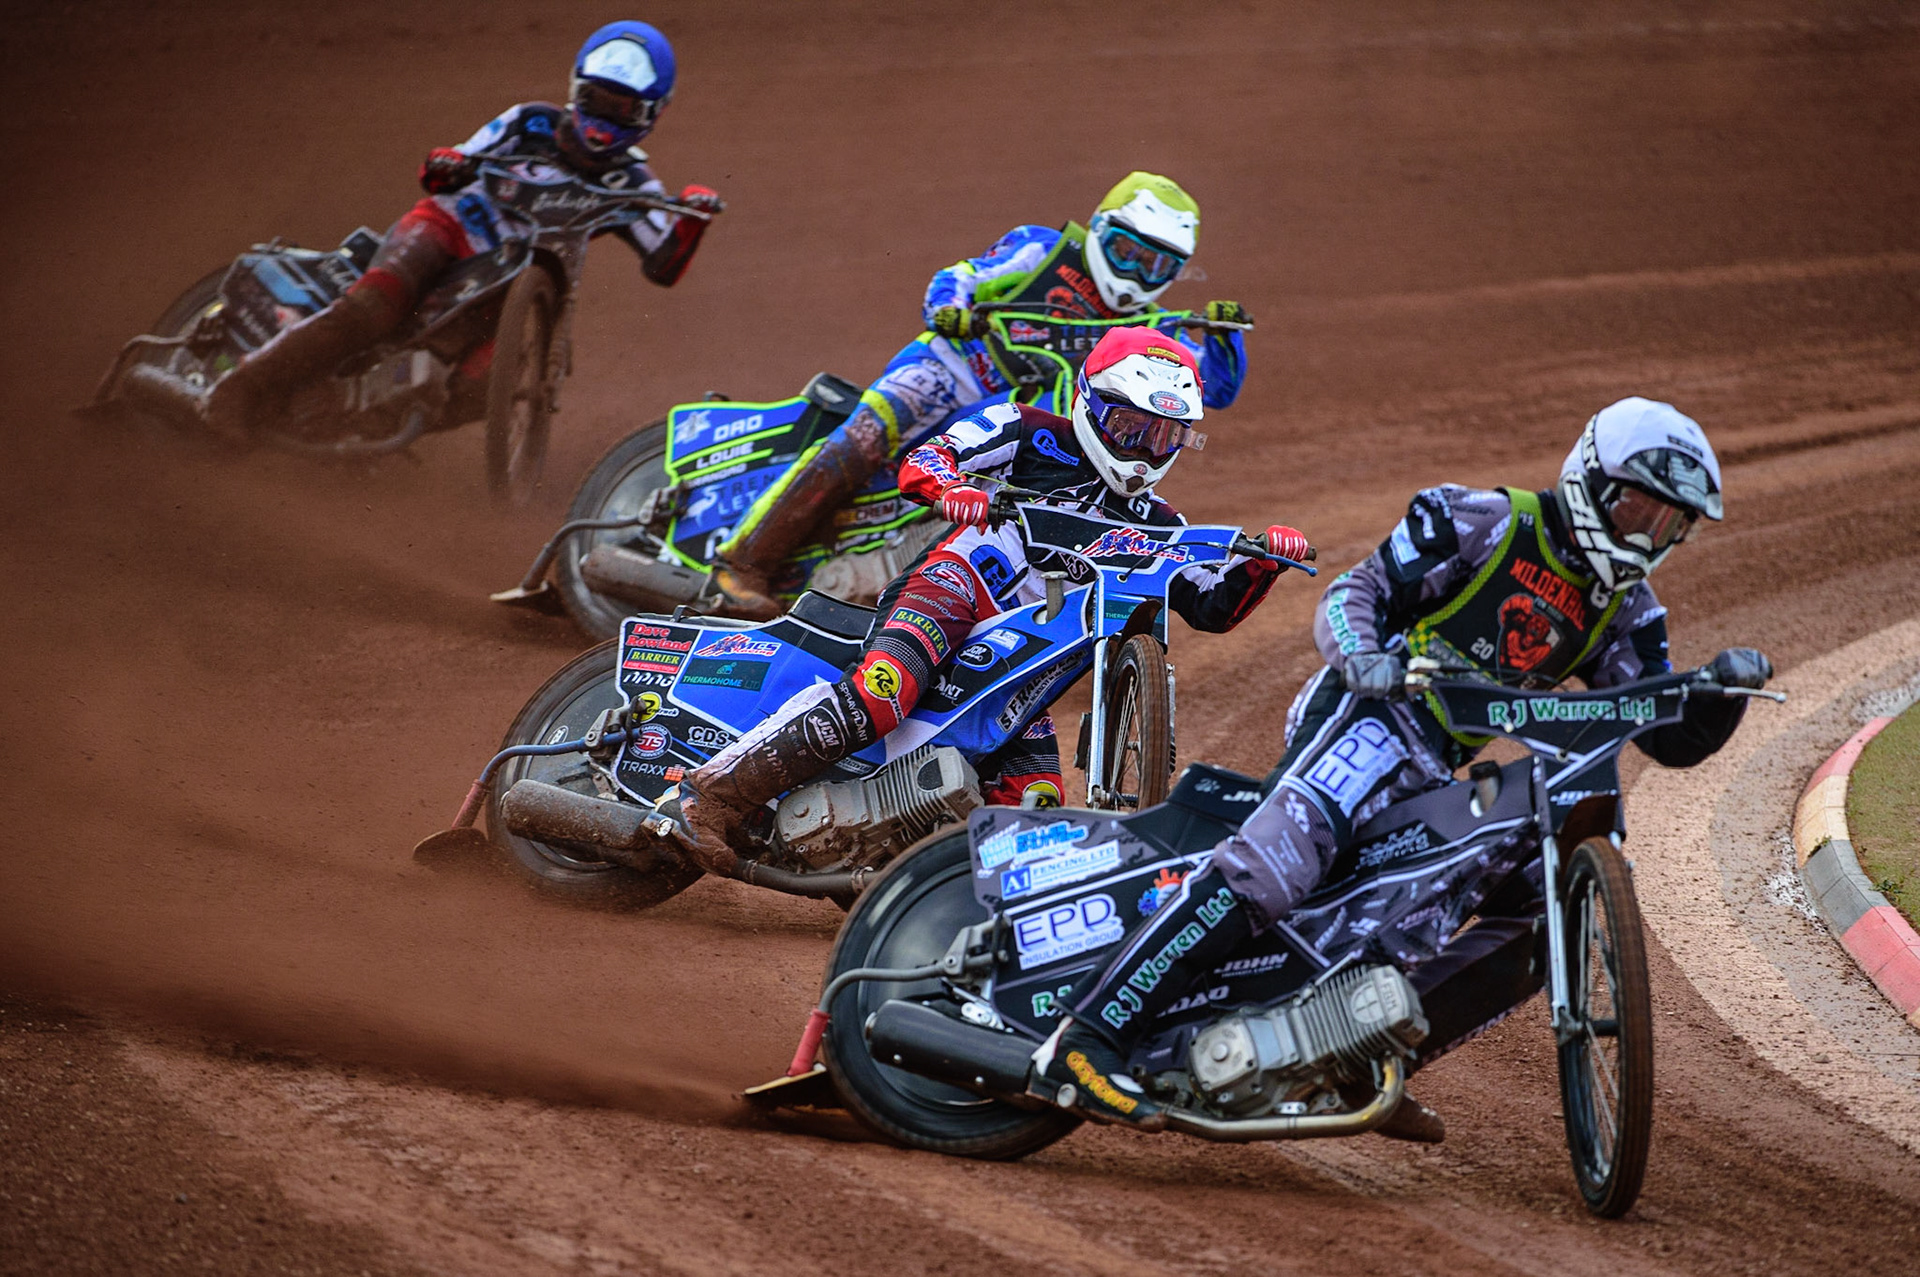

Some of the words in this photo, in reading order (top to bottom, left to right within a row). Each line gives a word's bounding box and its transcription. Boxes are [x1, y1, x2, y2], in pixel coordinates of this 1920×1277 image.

[1157, 398, 1182, 408] STS
[713, 414, 763, 442] DAD
[696, 441, 754, 470] LOUIE
[904, 592, 960, 622] THERMOHOME
[625, 635, 693, 652] Rowland
[632, 624, 671, 637] Dave
[896, 611, 945, 653] BARRIER
[906, 624, 939, 660] PROTECTION
[631, 651, 680, 664] BARRIER
[682, 675, 743, 687] THERMOHOME
[1490, 704, 1511, 724] R
[1512, 702, 1524, 726] J
[1533, 699, 1616, 719] Warren
[1619, 698, 1654, 719] Ltd
[636, 735, 662, 747] STS
[691, 727, 728, 745] CDS
[819, 719, 840, 747] JCM
[622, 760, 667, 777] TRAXX
[1311, 722, 1388, 793] EPD
[1004, 870, 1030, 894] A1
[1034, 856, 1086, 876] FENCING
[1090, 846, 1115, 861] LTD
[1018, 898, 1112, 948] EPD
[1023, 941, 1083, 964] INSULATION
[1085, 928, 1122, 949] GROUP
[1105, 1004, 1129, 1025] R
[1121, 990, 1140, 1011] J
[1132, 926, 1203, 990] Warren
[1200, 891, 1236, 925] Ltd
[1214, 952, 1288, 974] JOHN
